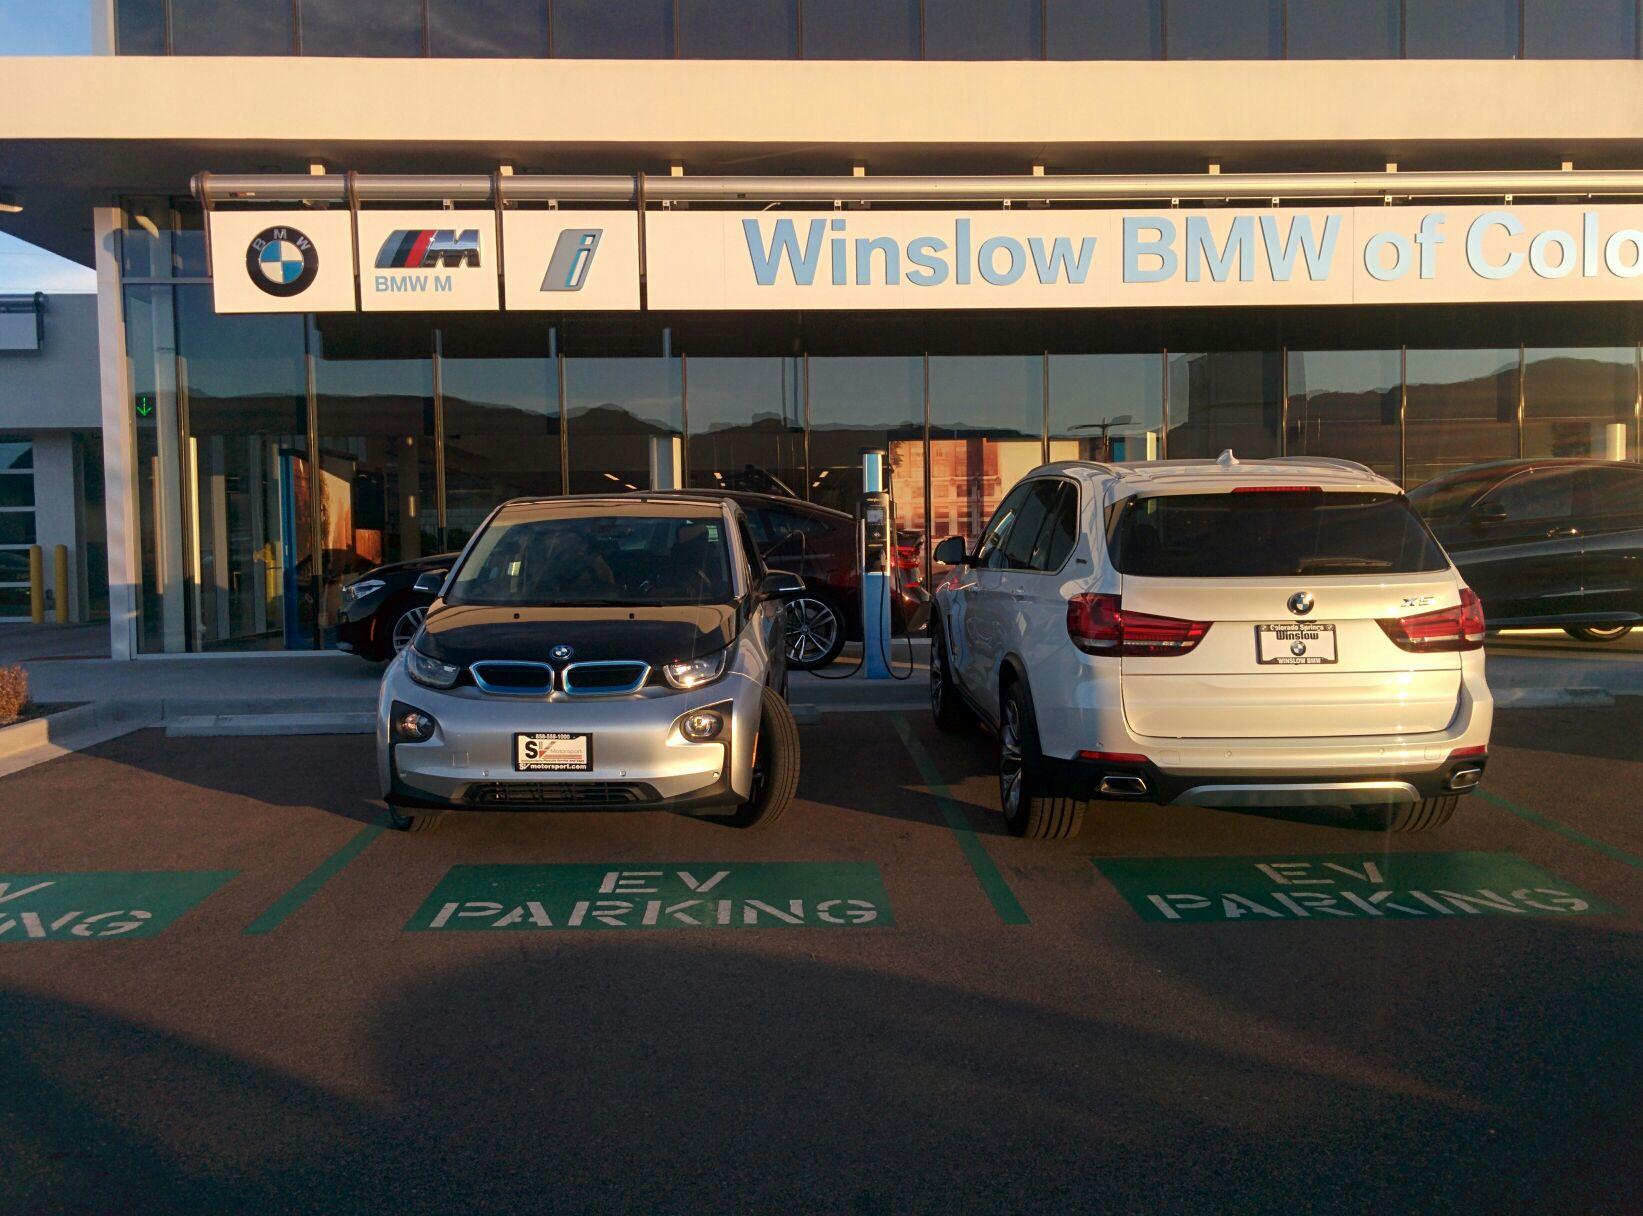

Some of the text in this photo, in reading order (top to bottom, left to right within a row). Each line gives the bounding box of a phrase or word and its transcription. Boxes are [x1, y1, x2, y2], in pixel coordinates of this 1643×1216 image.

[251, 227, 312, 253] BMW
[741, 209, 1643, 287] Winslow BMW of Colo
[375, 275, 452, 293] BMW M
[1276, 630, 1319, 641] Winslow
[1300, 624, 1325, 633] Springs
[598, 870, 731, 894] EV
[1254, 861, 1384, 886] EV
[429, 899, 878, 929] PARKING
[1146, 887, 1589, 920] PARKING
